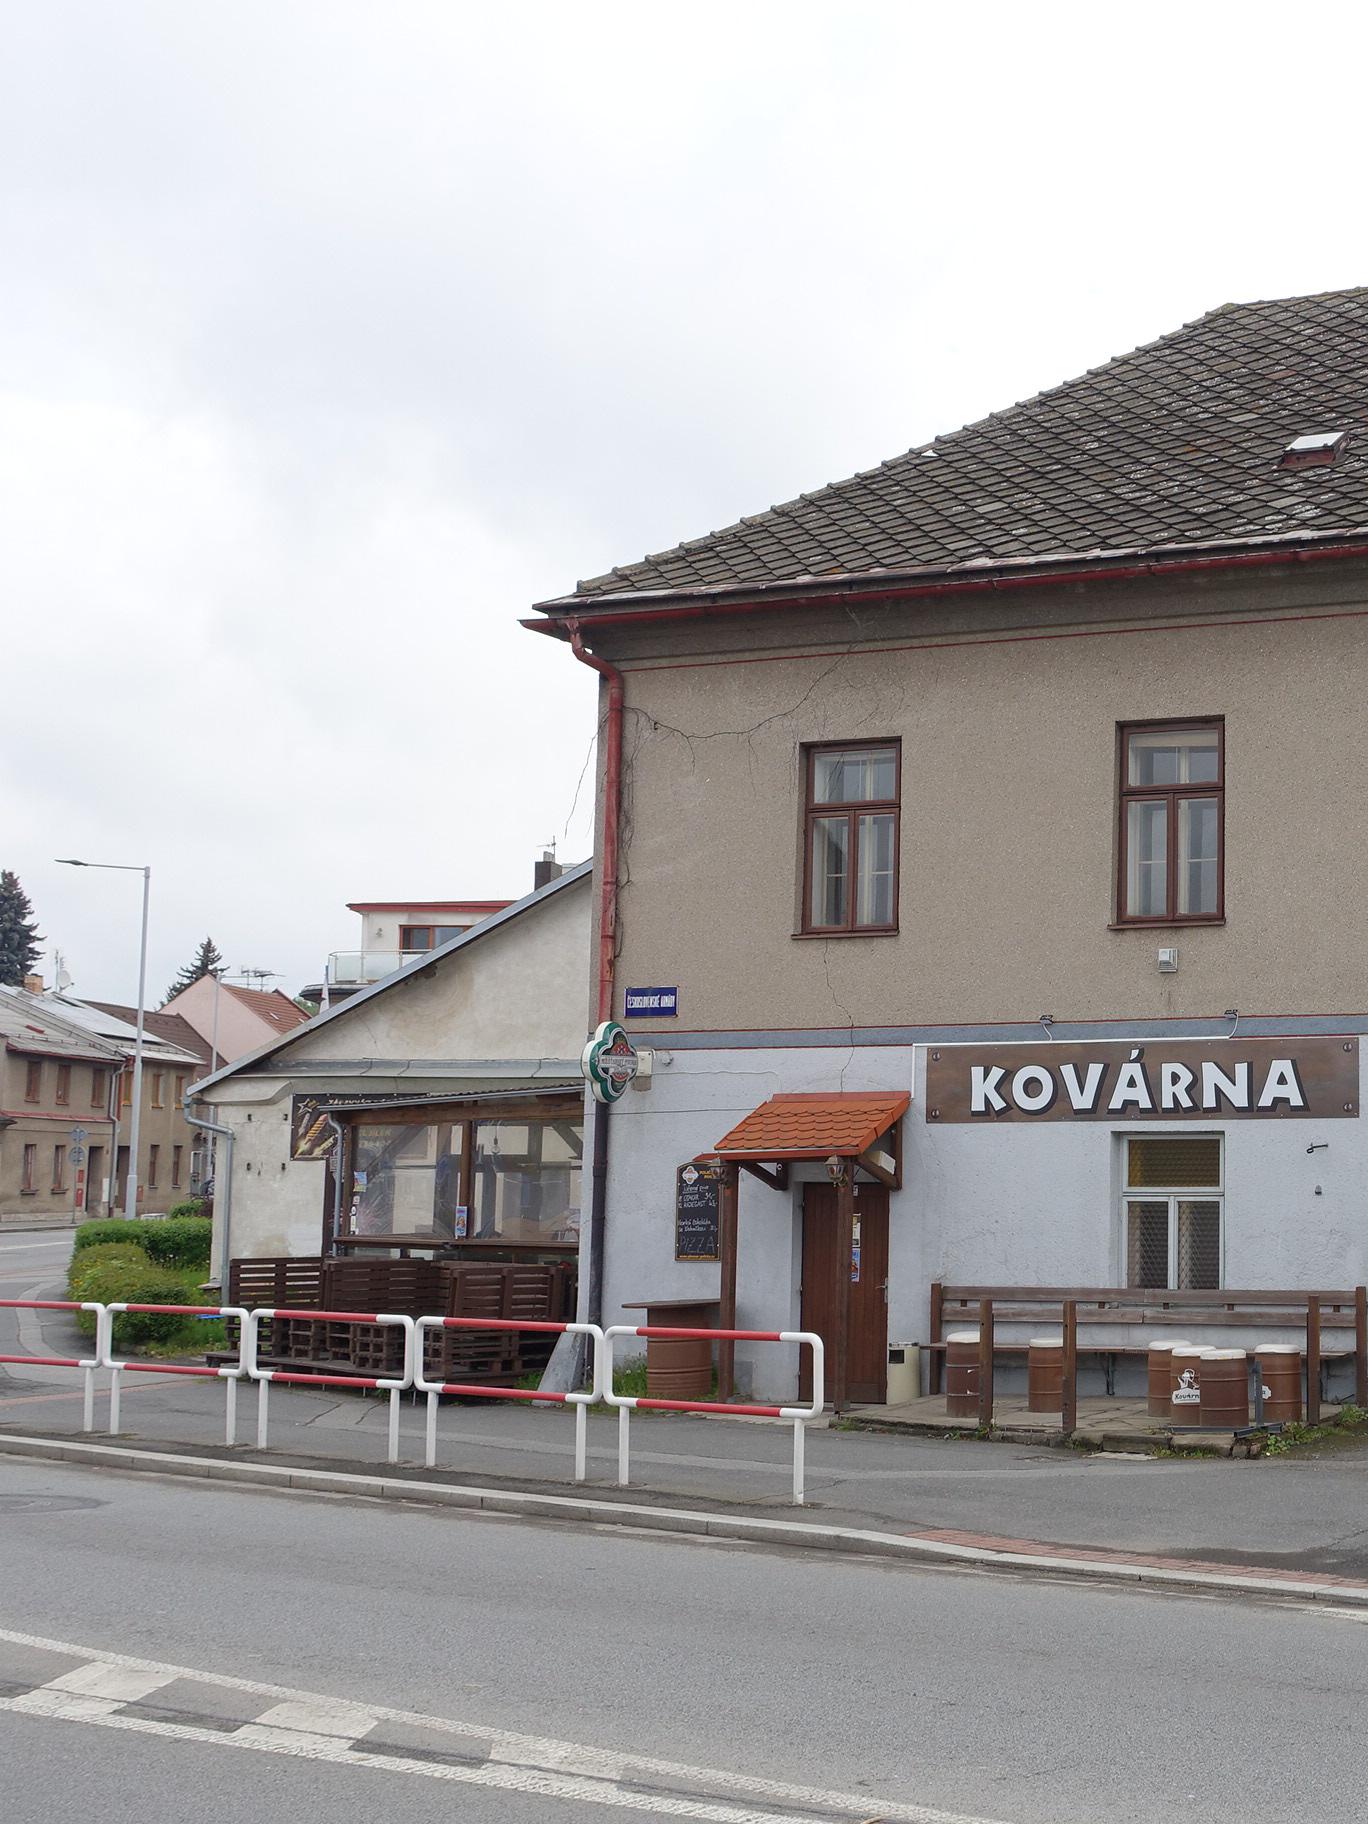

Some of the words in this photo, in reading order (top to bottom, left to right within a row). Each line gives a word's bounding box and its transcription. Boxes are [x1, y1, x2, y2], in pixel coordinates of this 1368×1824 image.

[970, 1048, 1308, 1113] KOVÁRNA
[679, 1236, 716, 1254] PIZZA
[1174, 1392, 1200, 1400] Kovárn
